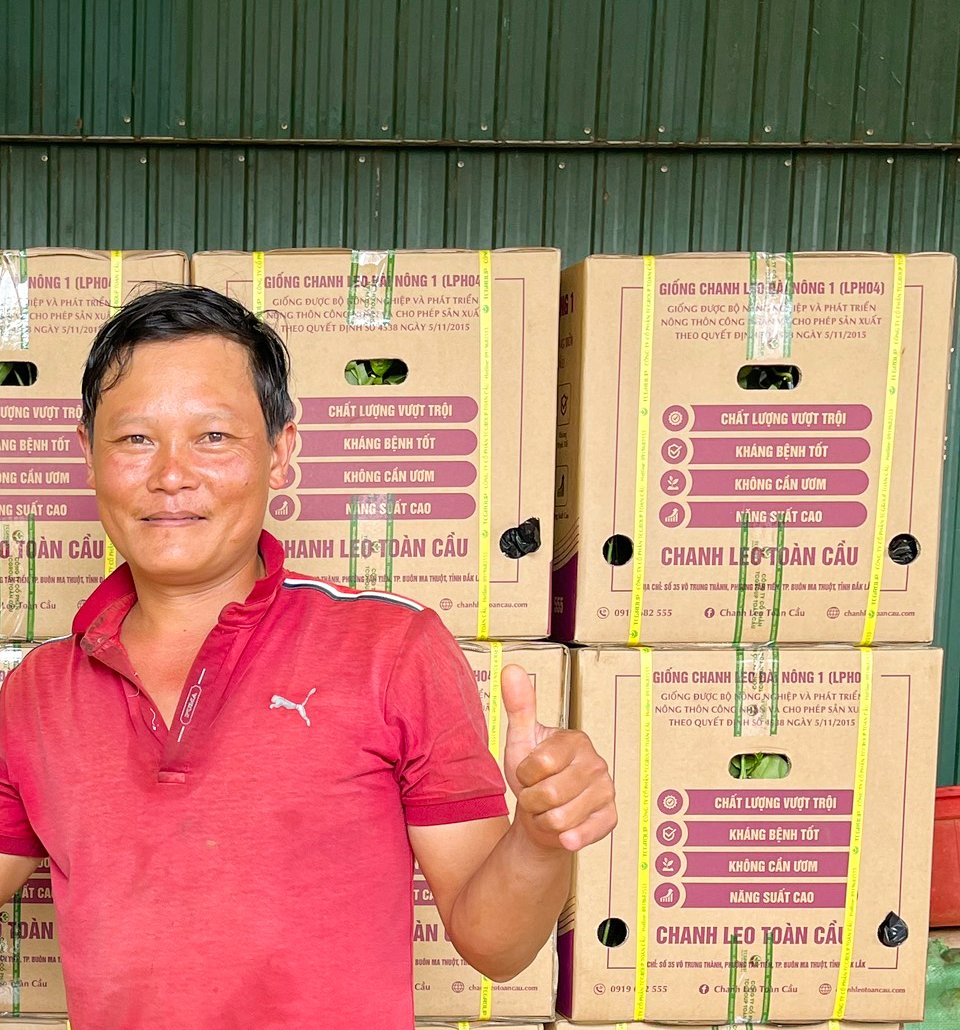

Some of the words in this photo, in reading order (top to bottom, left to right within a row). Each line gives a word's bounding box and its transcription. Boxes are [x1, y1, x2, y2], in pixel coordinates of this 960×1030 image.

[659, 281, 696, 295] GIỐNG
[700, 283, 740, 295] CHANH
[794, 282, 825, 294] NÔNG
[829, 282, 834, 294] 1
[840, 282, 884, 294] (LPH04)
[400, 323, 426, 332] NGÀY
[429, 323, 470, 331] 5/11/2015
[661, 317, 688, 326] NÔNG
[690, 317, 717, 326] THÔN
[718, 317, 744, 326] CÔNG
[33, 406, 60, 421] VƯỢT
[328, 401, 357, 417] CHẤT
[359, 404, 395, 419] LƯỢNG
[398, 404, 426, 419] VƯỢT
[428, 402, 452, 419] TRỘI
[721, 409, 749, 425] CHẤT
[752, 412, 788, 427] LƯỢNG
[791, 412, 819, 427] VƯỢT
[822, 410, 846, 427] TRỘI
[344, 436, 381, 450] KHÁNG
[384, 435, 413, 452] BỆNH
[416, 433, 436, 449] TỐT
[736, 443, 773, 457] KHÁNG
[776, 443, 806, 460] BỆNH
[808, 441, 829, 457] TỐT
[661, 547, 723, 566] CHANH
[822, 542, 859, 566] CẦU
[729, 858, 765, 872] KHÔNG
[768, 857, 791, 872] CẦN
[793, 860, 818, 872] ƯƠM
[730, 889, 760, 903] NĂNG
[763, 888, 791, 903] SUẤT
[793, 891, 814, 903] CAO
[656, 927, 717, 944] CHANH
